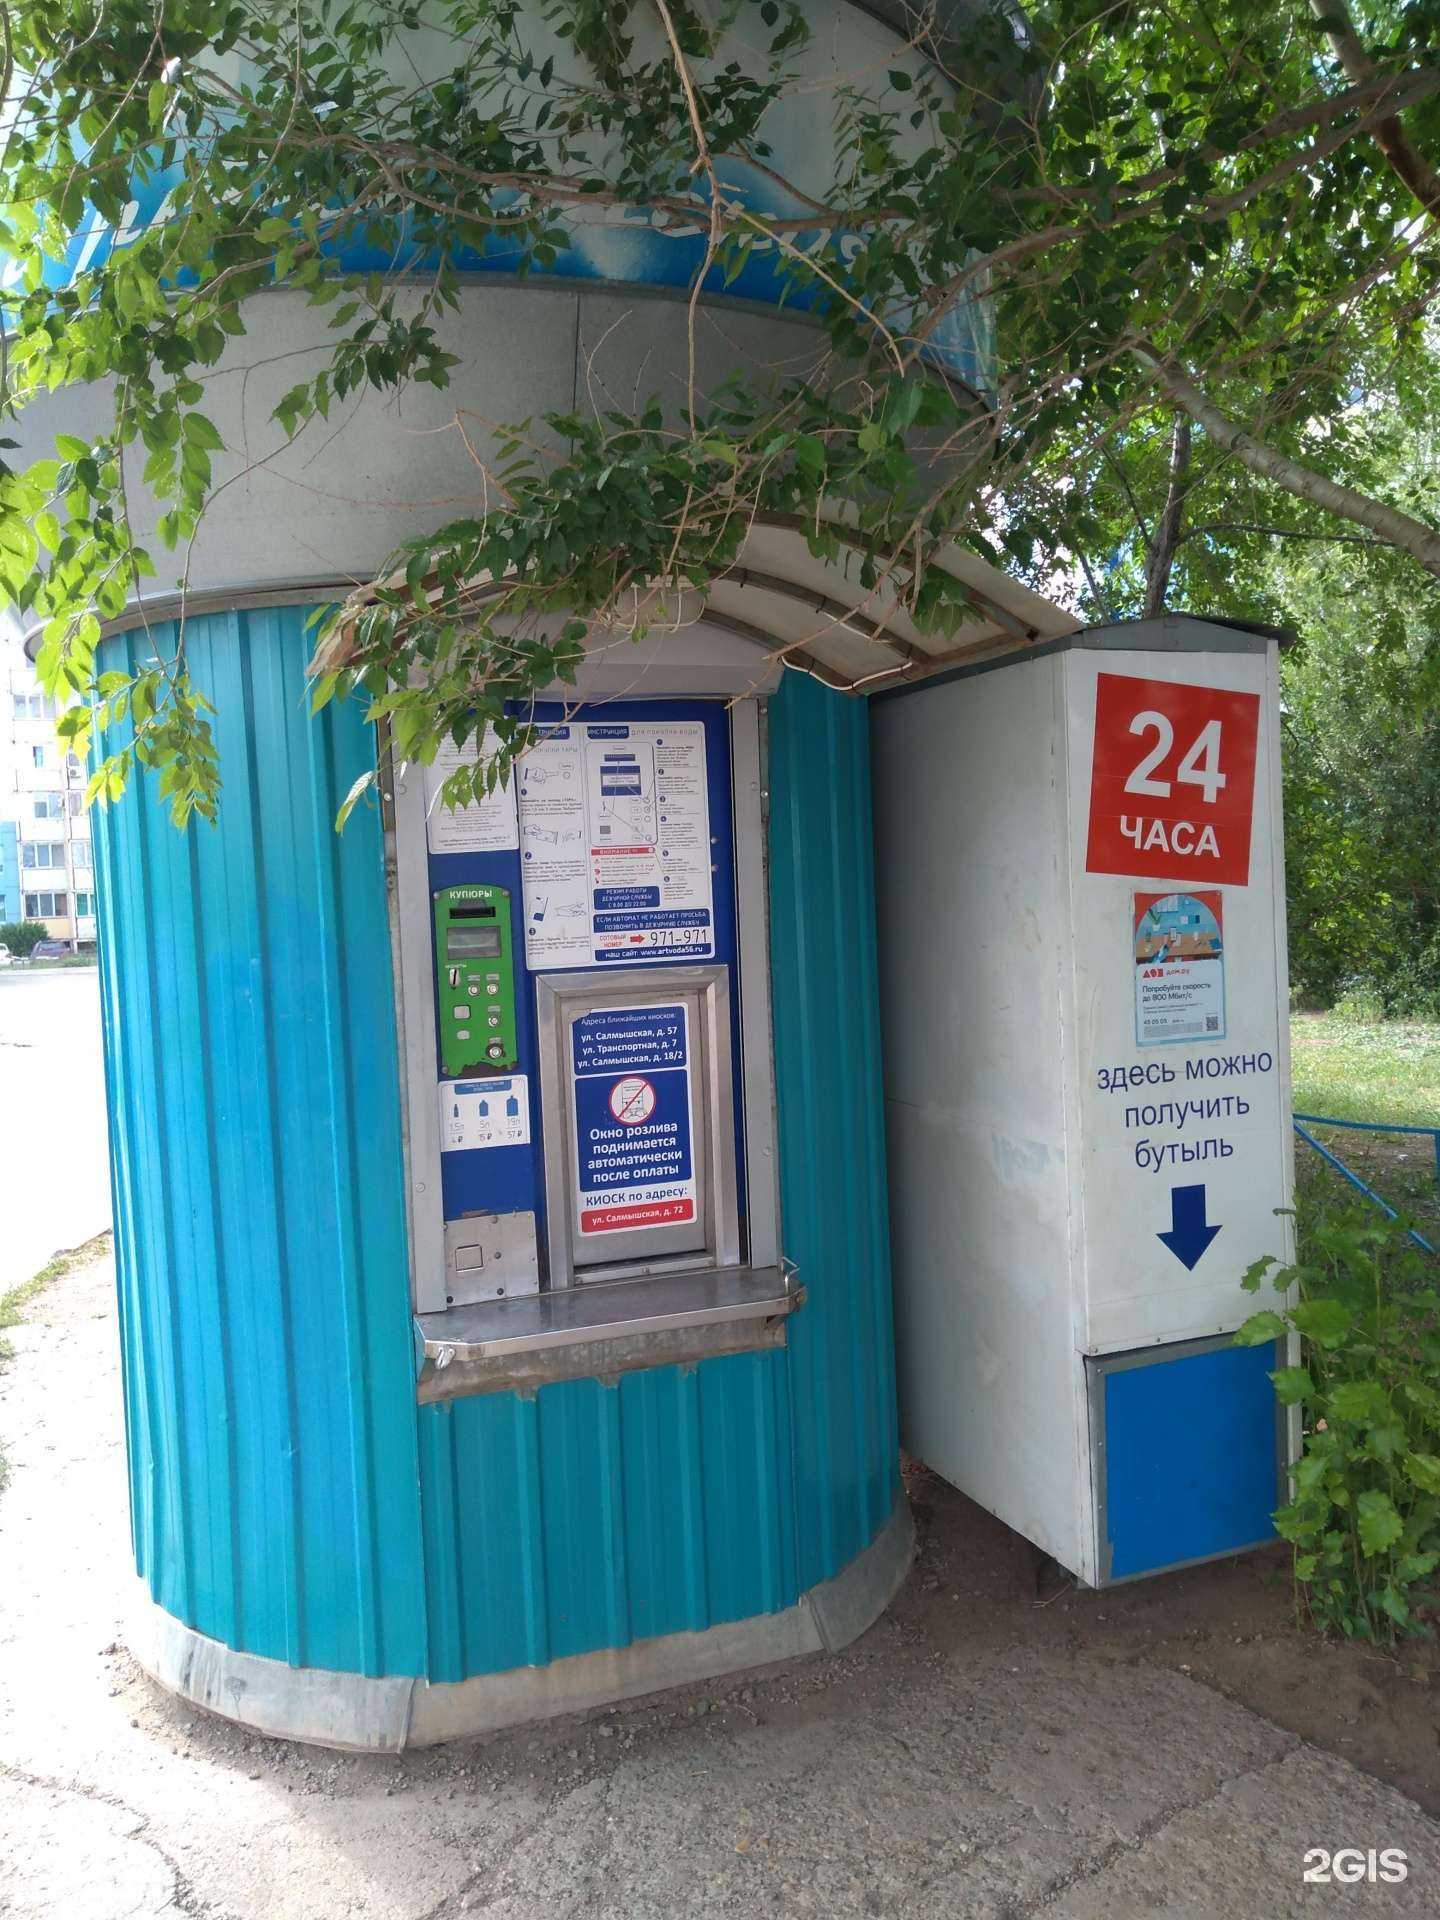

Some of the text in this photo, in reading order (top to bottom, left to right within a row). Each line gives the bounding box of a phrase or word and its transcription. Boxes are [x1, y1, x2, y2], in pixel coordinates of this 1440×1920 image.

[1124, 710, 1227, 804] 24
[1120, 814, 1220, 858] ЧАСА
[450, 890, 492, 899] КУПЮРЫ
[650, 912, 680, 920] РАБОТАЕТ
[650, 930, 708, 946] 971-971
[1142, 984, 1181, 994] Попробуйте
[1152, 993, 1166, 1001] 800
[581, 1018, 606, 1026] Адреса
[606, 1014, 646, 1024] ближайших
[581, 1026, 678, 1043] ул. Салмышская, д. 57
[582, 1048, 596, 1056] ул.
[598, 1042, 660, 1055] Транспортная,
[672, 1039, 677, 1047] 7
[578, 1051, 684, 1069] ул. Салмышская, д. 18/2
[1097, 1052, 1272, 1094] здесь можно
[1125, 1096, 1250, 1130] получить
[590, 1123, 678, 1140] Окно розлива
[593, 1137, 676, 1155] поднимается
[588, 1150, 682, 1170] автоматически
[1135, 1138, 1234, 1174] бутыль
[593, 1164, 679, 1183] после оплаты
[586, 1186, 688, 1206] КИОСК по адресу:
[592, 1206, 684, 1225] ул. Салмышская, д. 72
